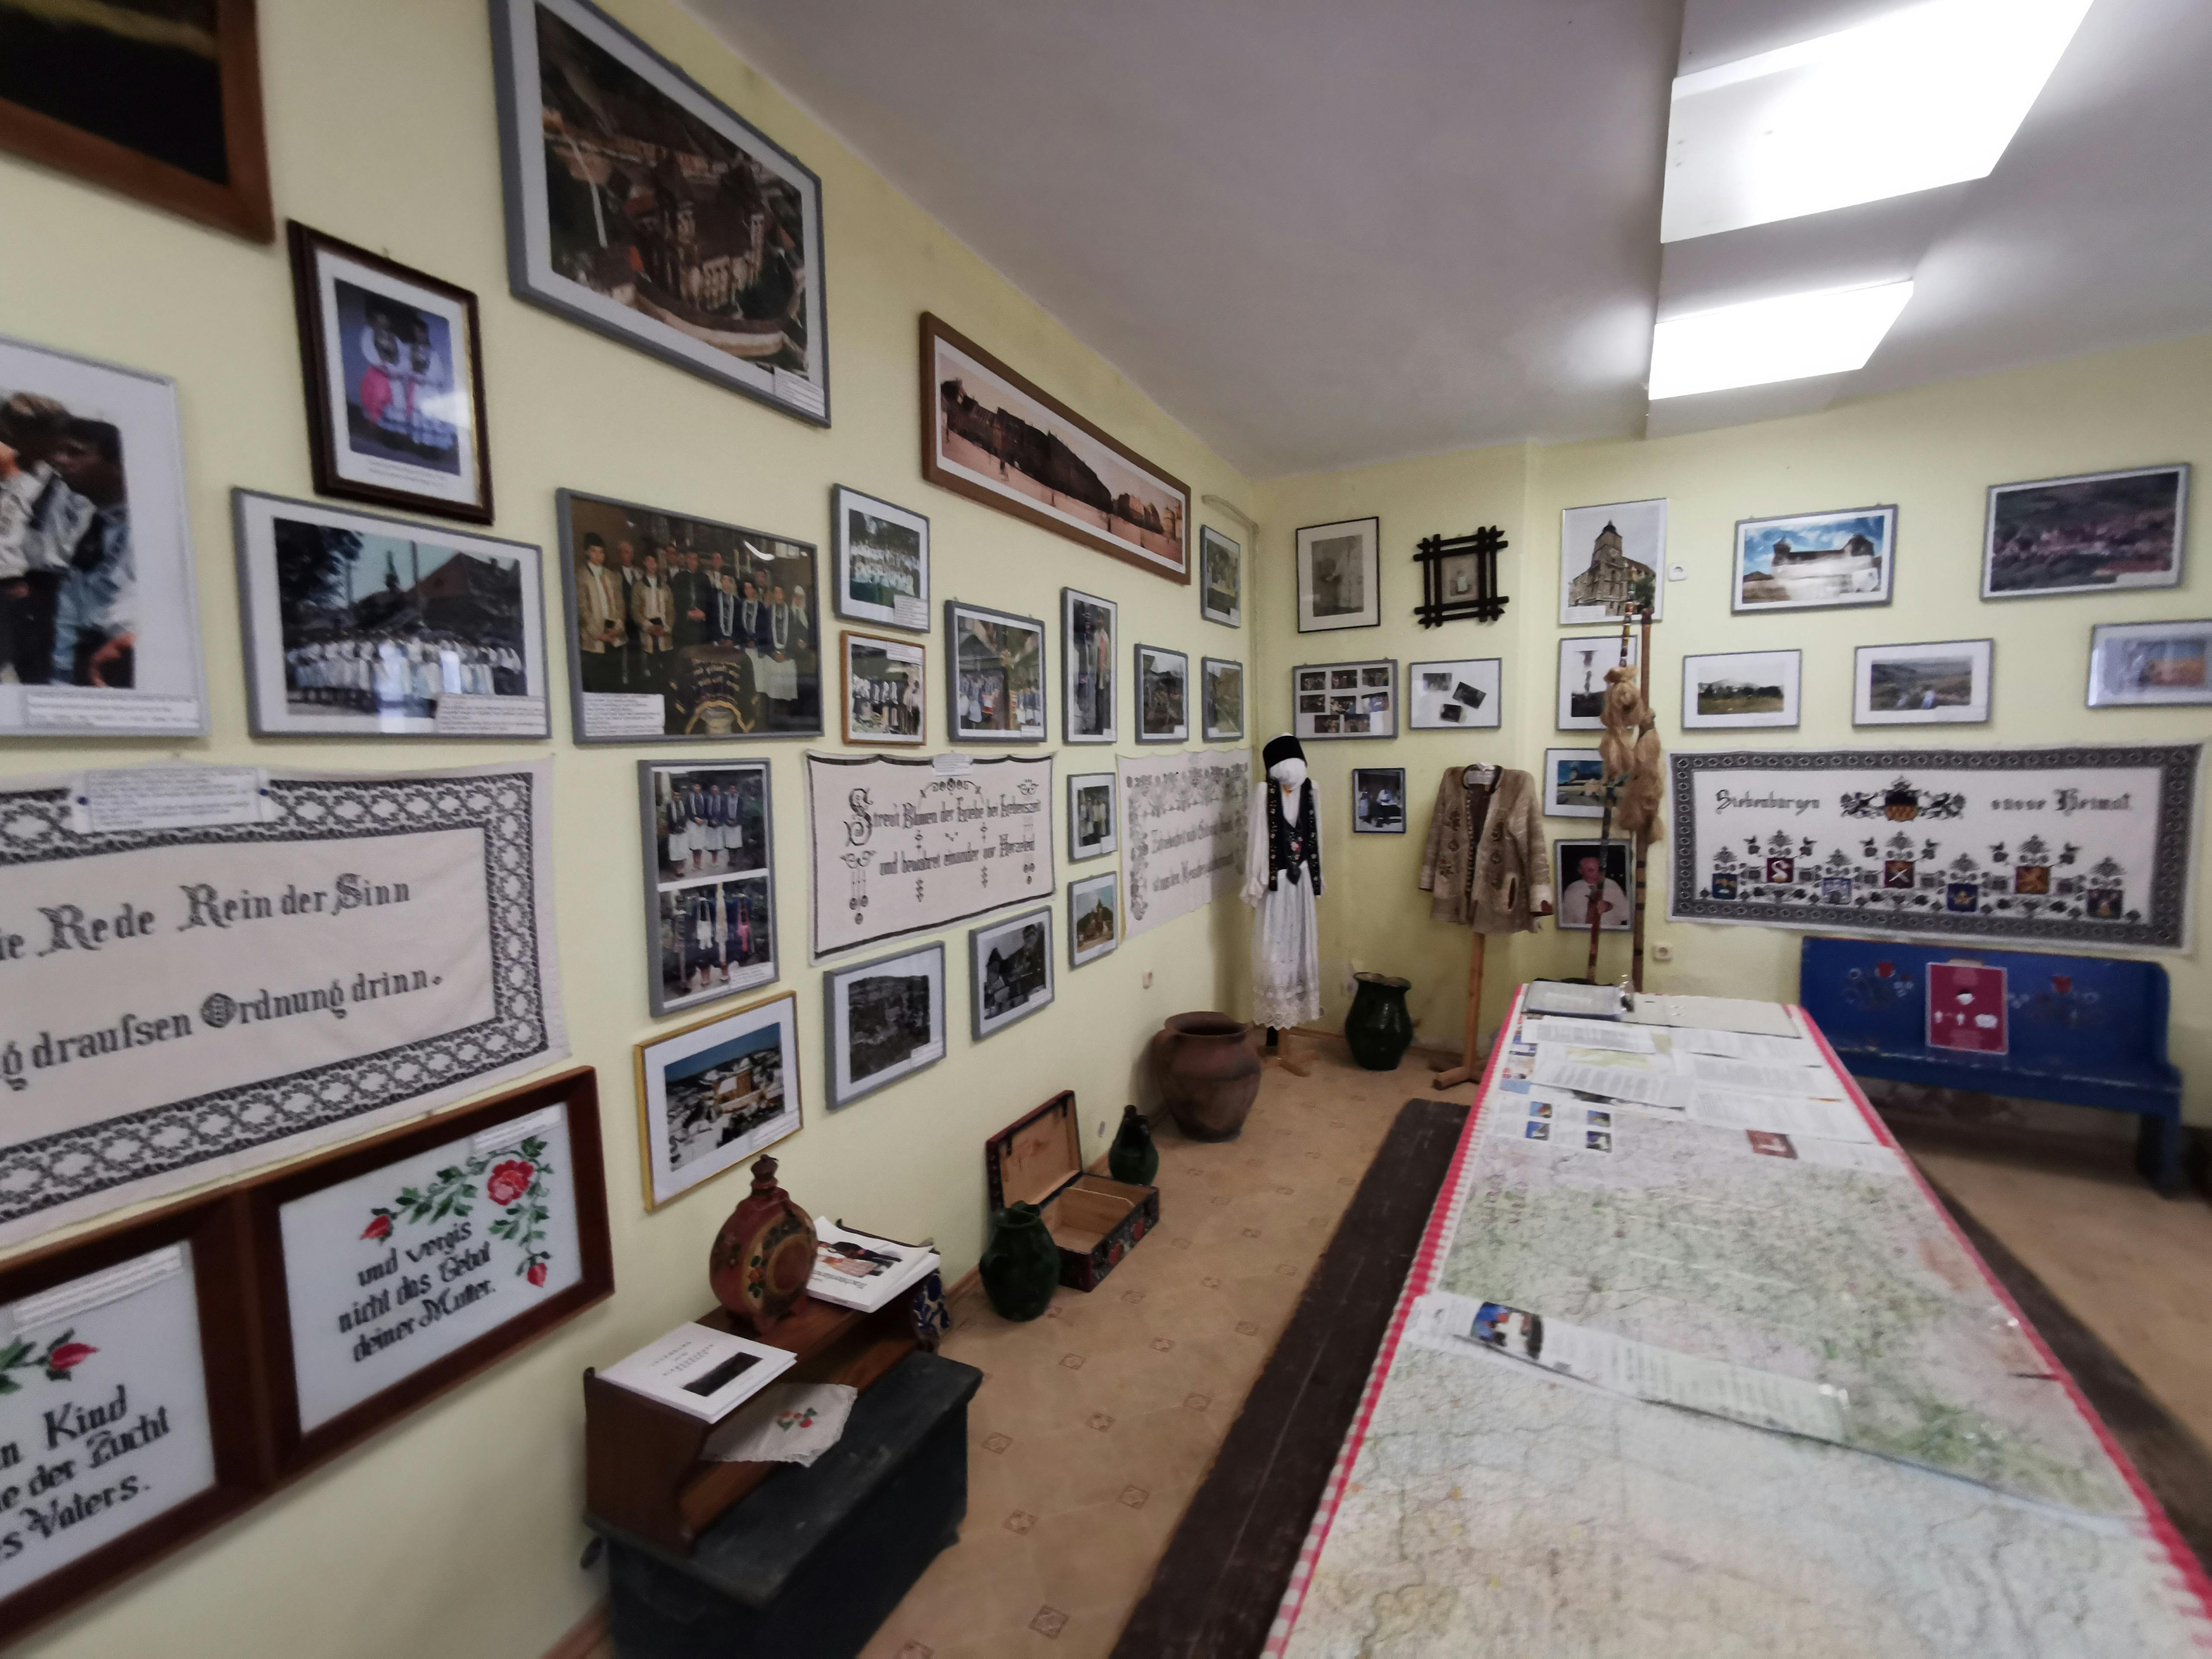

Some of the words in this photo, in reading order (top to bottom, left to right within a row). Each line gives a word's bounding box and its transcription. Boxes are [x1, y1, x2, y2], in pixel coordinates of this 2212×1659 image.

[940, 801, 954, 822] der
[36, 903, 156, 957] Rede
[176, 883, 274, 932] Rein
[280, 884, 328, 915] der
[331, 872, 410, 916] Sinn
[199, 979, 348, 1029] Ordnung
[357, 1247, 398, 1287] und
[339, 1288, 391, 1333] nicht
[396, 1274, 432, 1306] das
[353, 1317, 416, 1362] deiner
[43, 1383, 128, 1450] Kind
[28, 1460, 76, 1497] der
